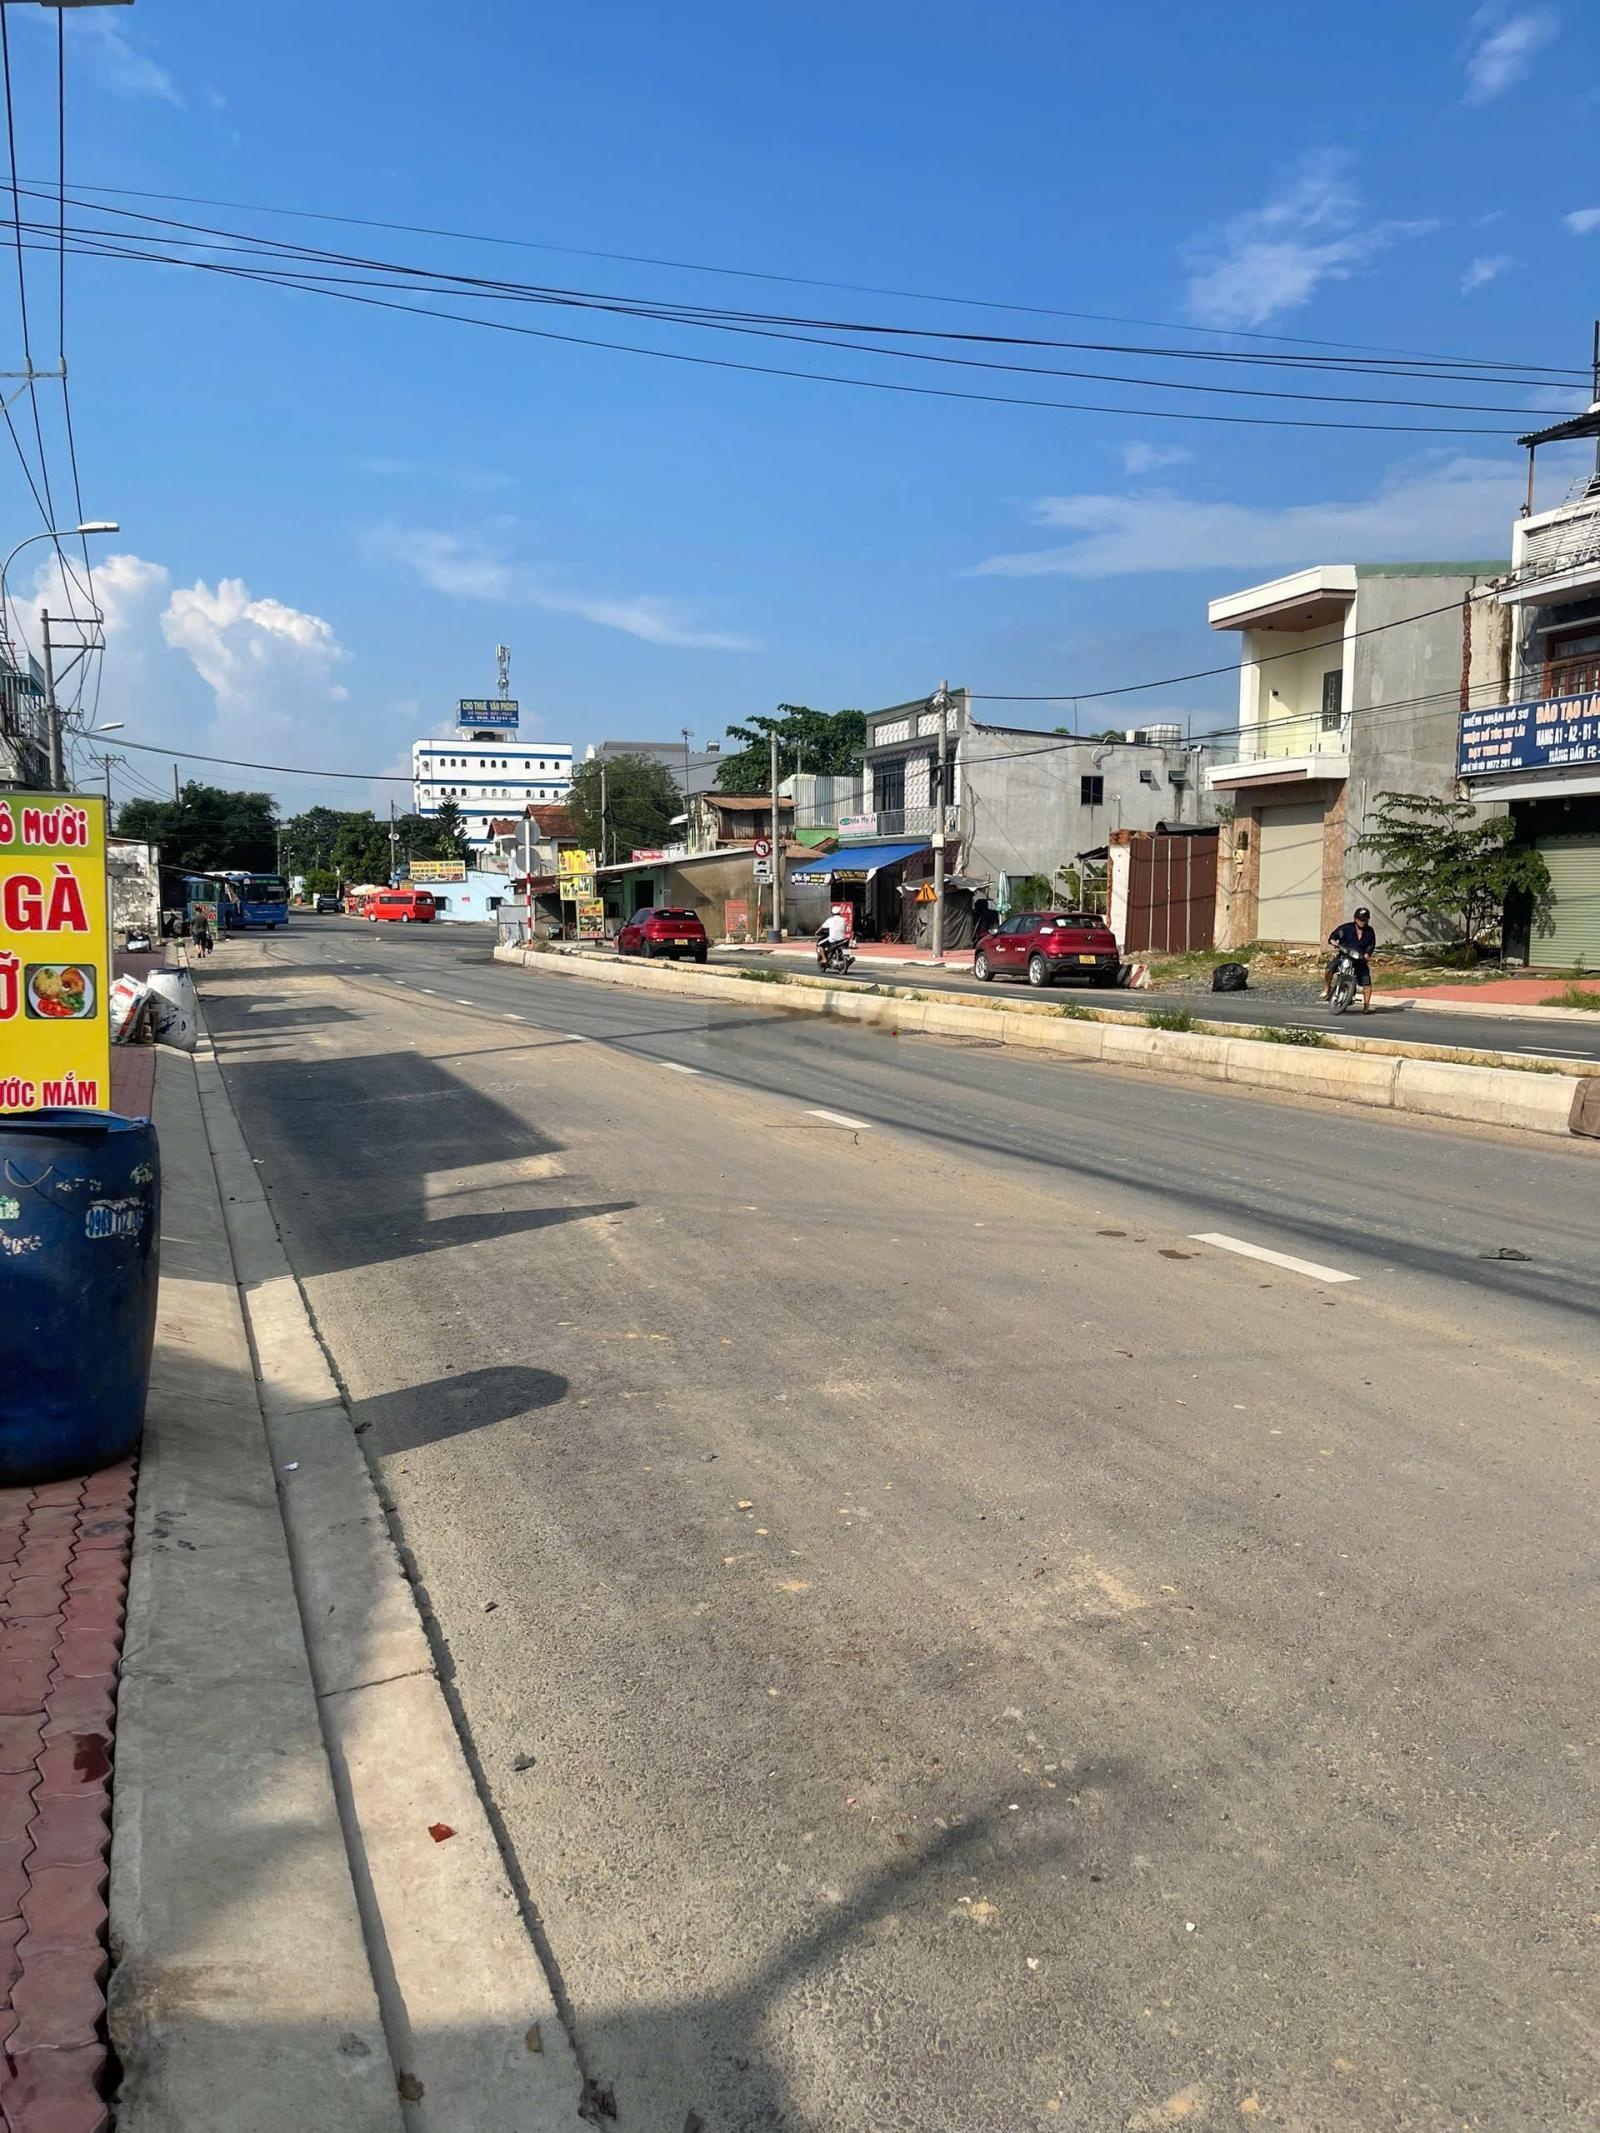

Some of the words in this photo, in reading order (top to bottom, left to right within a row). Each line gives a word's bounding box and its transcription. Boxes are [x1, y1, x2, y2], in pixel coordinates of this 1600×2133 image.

[1483, 711, 1504, 725] NHẬN
[1517, 708, 1529, 720] SƠ
[1536, 702, 1558, 725] ĐÀO
[1560, 700, 1581, 724] TẠO
[1554, 727, 1563, 745] A1
[1568, 725, 1578, 743] A2
[1582, 723, 1592, 741] B1
[1587, 745, 1597, 759] FC
[4, 865, 89, 931] GÀ
[42, 1072, 97, 1106] MẮM
